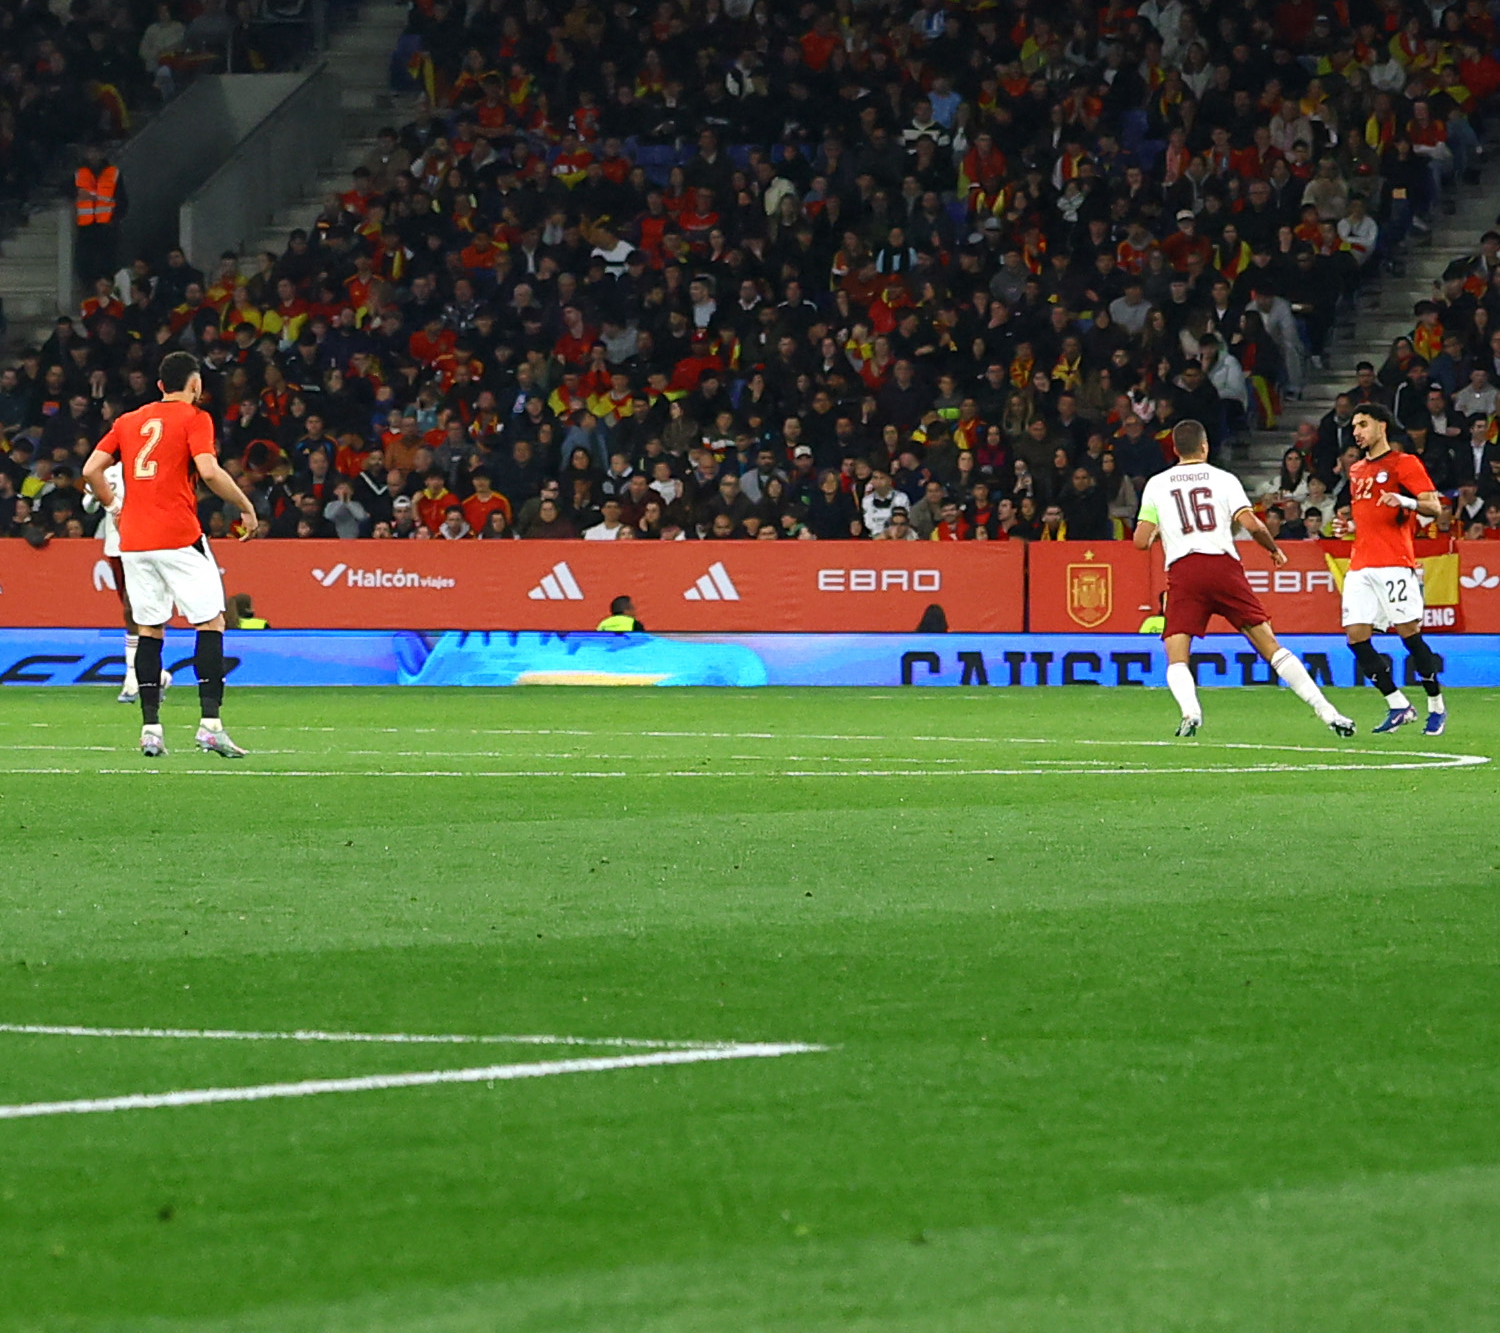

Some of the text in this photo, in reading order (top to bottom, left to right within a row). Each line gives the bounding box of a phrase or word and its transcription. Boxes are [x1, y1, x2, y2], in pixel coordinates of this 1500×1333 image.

[133, 418, 164, 480] 2
[1170, 486, 1217, 535] 16
[346, 568, 455, 590] Halcón viajes
[1385, 579, 1408, 603] 22
